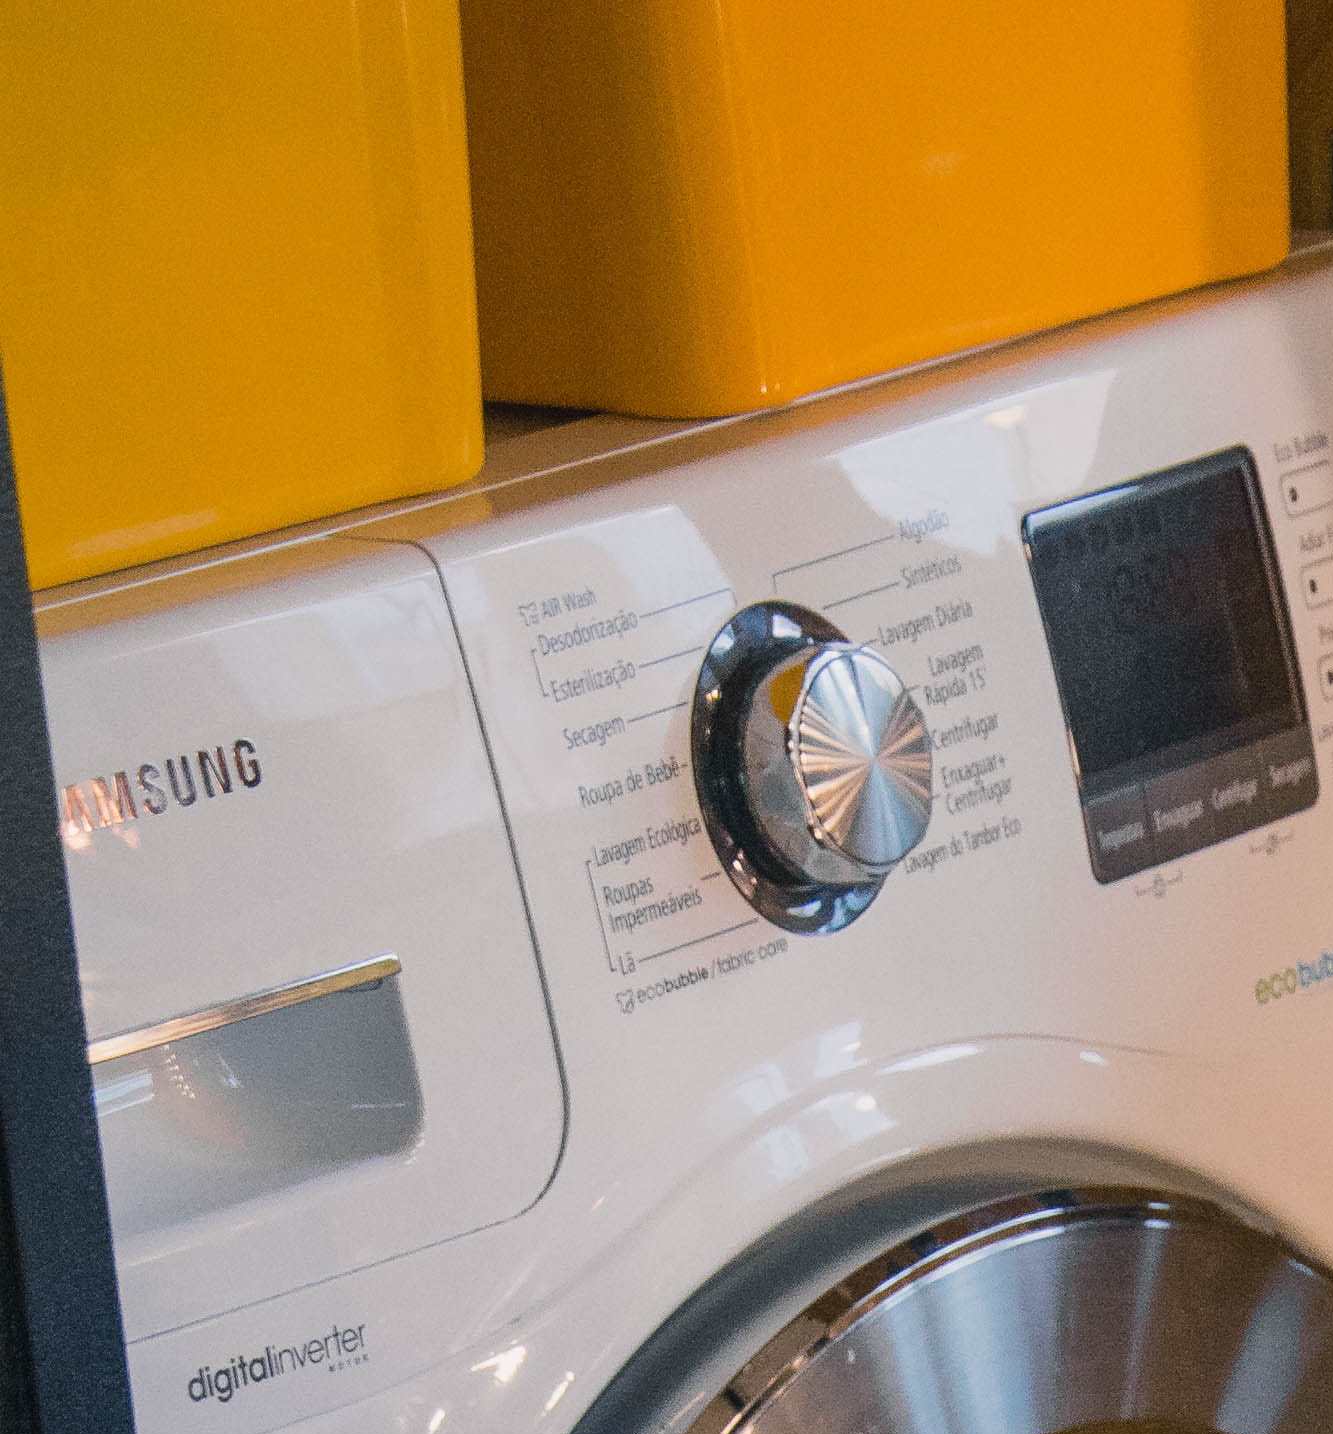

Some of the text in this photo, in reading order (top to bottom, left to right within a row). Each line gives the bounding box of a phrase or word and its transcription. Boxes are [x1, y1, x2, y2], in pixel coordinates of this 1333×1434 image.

[899, 509, 949, 544] Algodão
[902, 555, 962, 589] Sintéticos
[541, 586, 597, 619] AIR Wash
[537, 609, 639, 656] Desodorização
[877, 600, 974, 647] Lavagem Diária
[927, 643, 984, 677] Lavagem
[550, 659, 637, 702] Esterilização
[922, 676, 968, 706] Rápida
[562, 715, 627, 750] Secagem
[932, 711, 999, 750] Centrifugar
[63, 739, 262, 833] AMSUNG
[577, 756, 680, 808] Roupa de Bebê
[946, 776, 1013, 815] Centrifugar
[592, 815, 702, 868] Lavagem Ecológica
[903, 815, 1023, 875] Lavagem do Tambor Eco
[602, 876, 654, 908] Roupas
[608, 886, 704, 935] Impermeáveis
[617, 952, 636, 976] Lã
[717, 946, 756, 976] fabric
[758, 936, 790, 959] care
